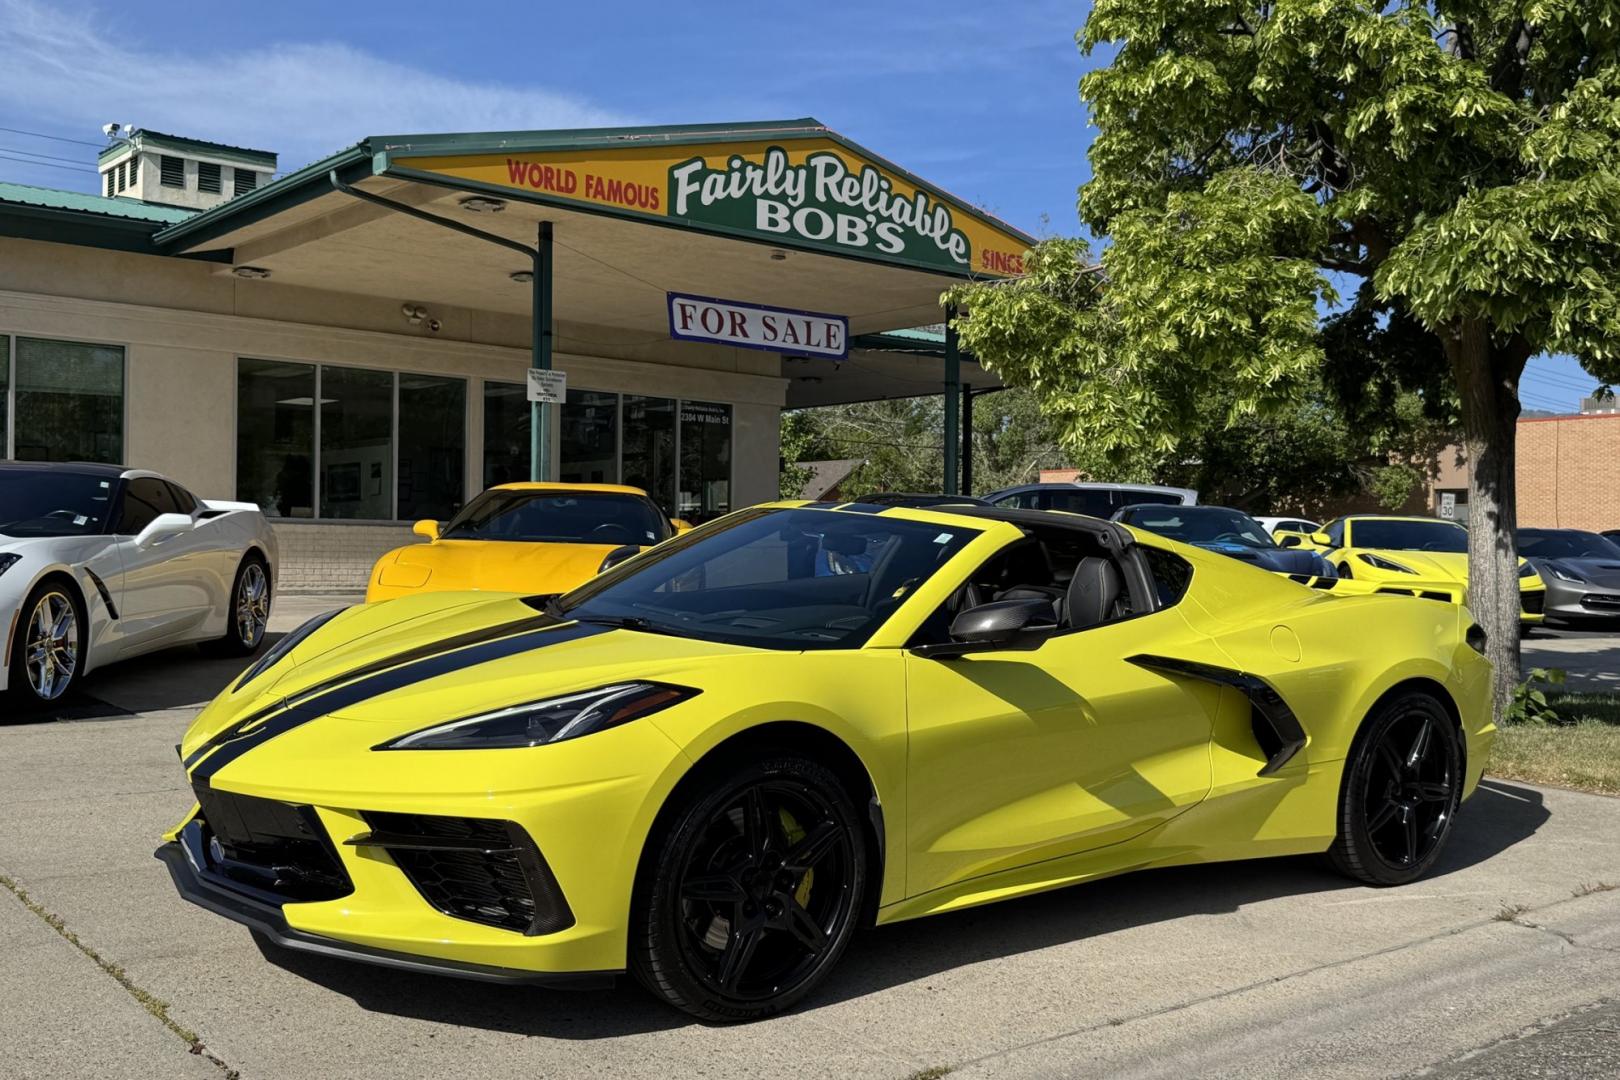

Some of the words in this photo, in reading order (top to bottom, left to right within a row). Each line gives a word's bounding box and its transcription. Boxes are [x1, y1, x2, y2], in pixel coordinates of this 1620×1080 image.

[506, 158, 577, 194] WORLD
[585, 174, 660, 210] FAMOUS
[673, 150, 806, 215] Fairly
[810, 155, 967, 264] Reliable
[756, 198, 905, 253] BOB'S
[982, 248, 1024, 273] SINCE
[677, 302, 750, 338] FOR
[761, 315, 841, 350] SALE
[697, 414, 704, 422] W
[705, 414, 721, 424] Main
[721, 416, 729, 424] St
[1442, 506, 1452, 516] 30
